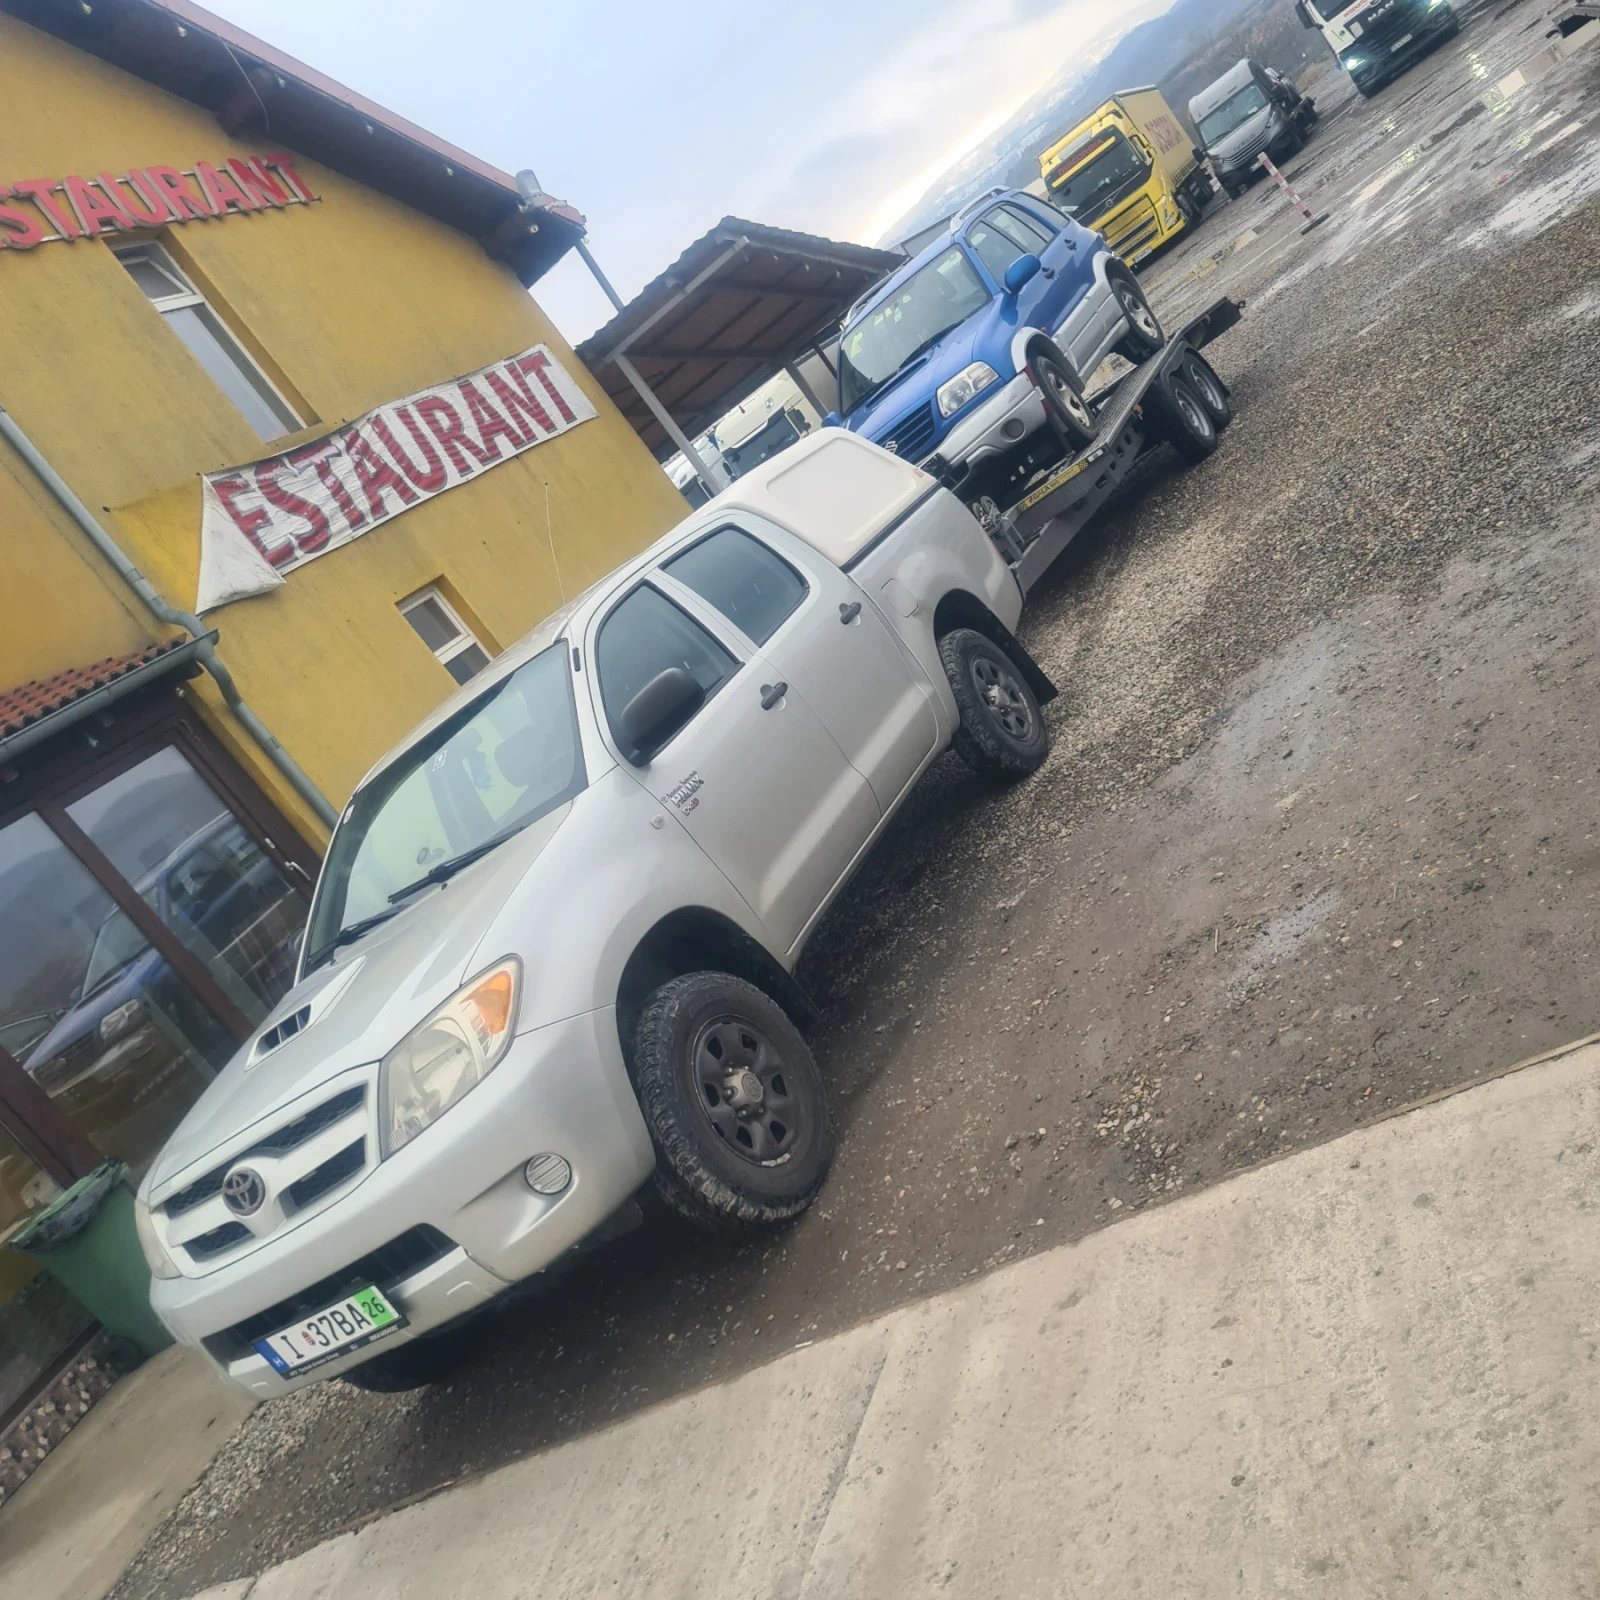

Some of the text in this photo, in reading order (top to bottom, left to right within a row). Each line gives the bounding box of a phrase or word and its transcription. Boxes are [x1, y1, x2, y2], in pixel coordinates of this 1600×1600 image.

[1367, 0, 1394, 23] MAN
[1058, 139, 1104, 176] DISCORDIA
[1233, 133, 1257, 151] IVECO
[210, 350, 577, 570] ESTAURANT
[671, 774, 704, 808] HILUX
[280, 1334, 304, 1359] I
[361, 1296, 386, 1319] 26
